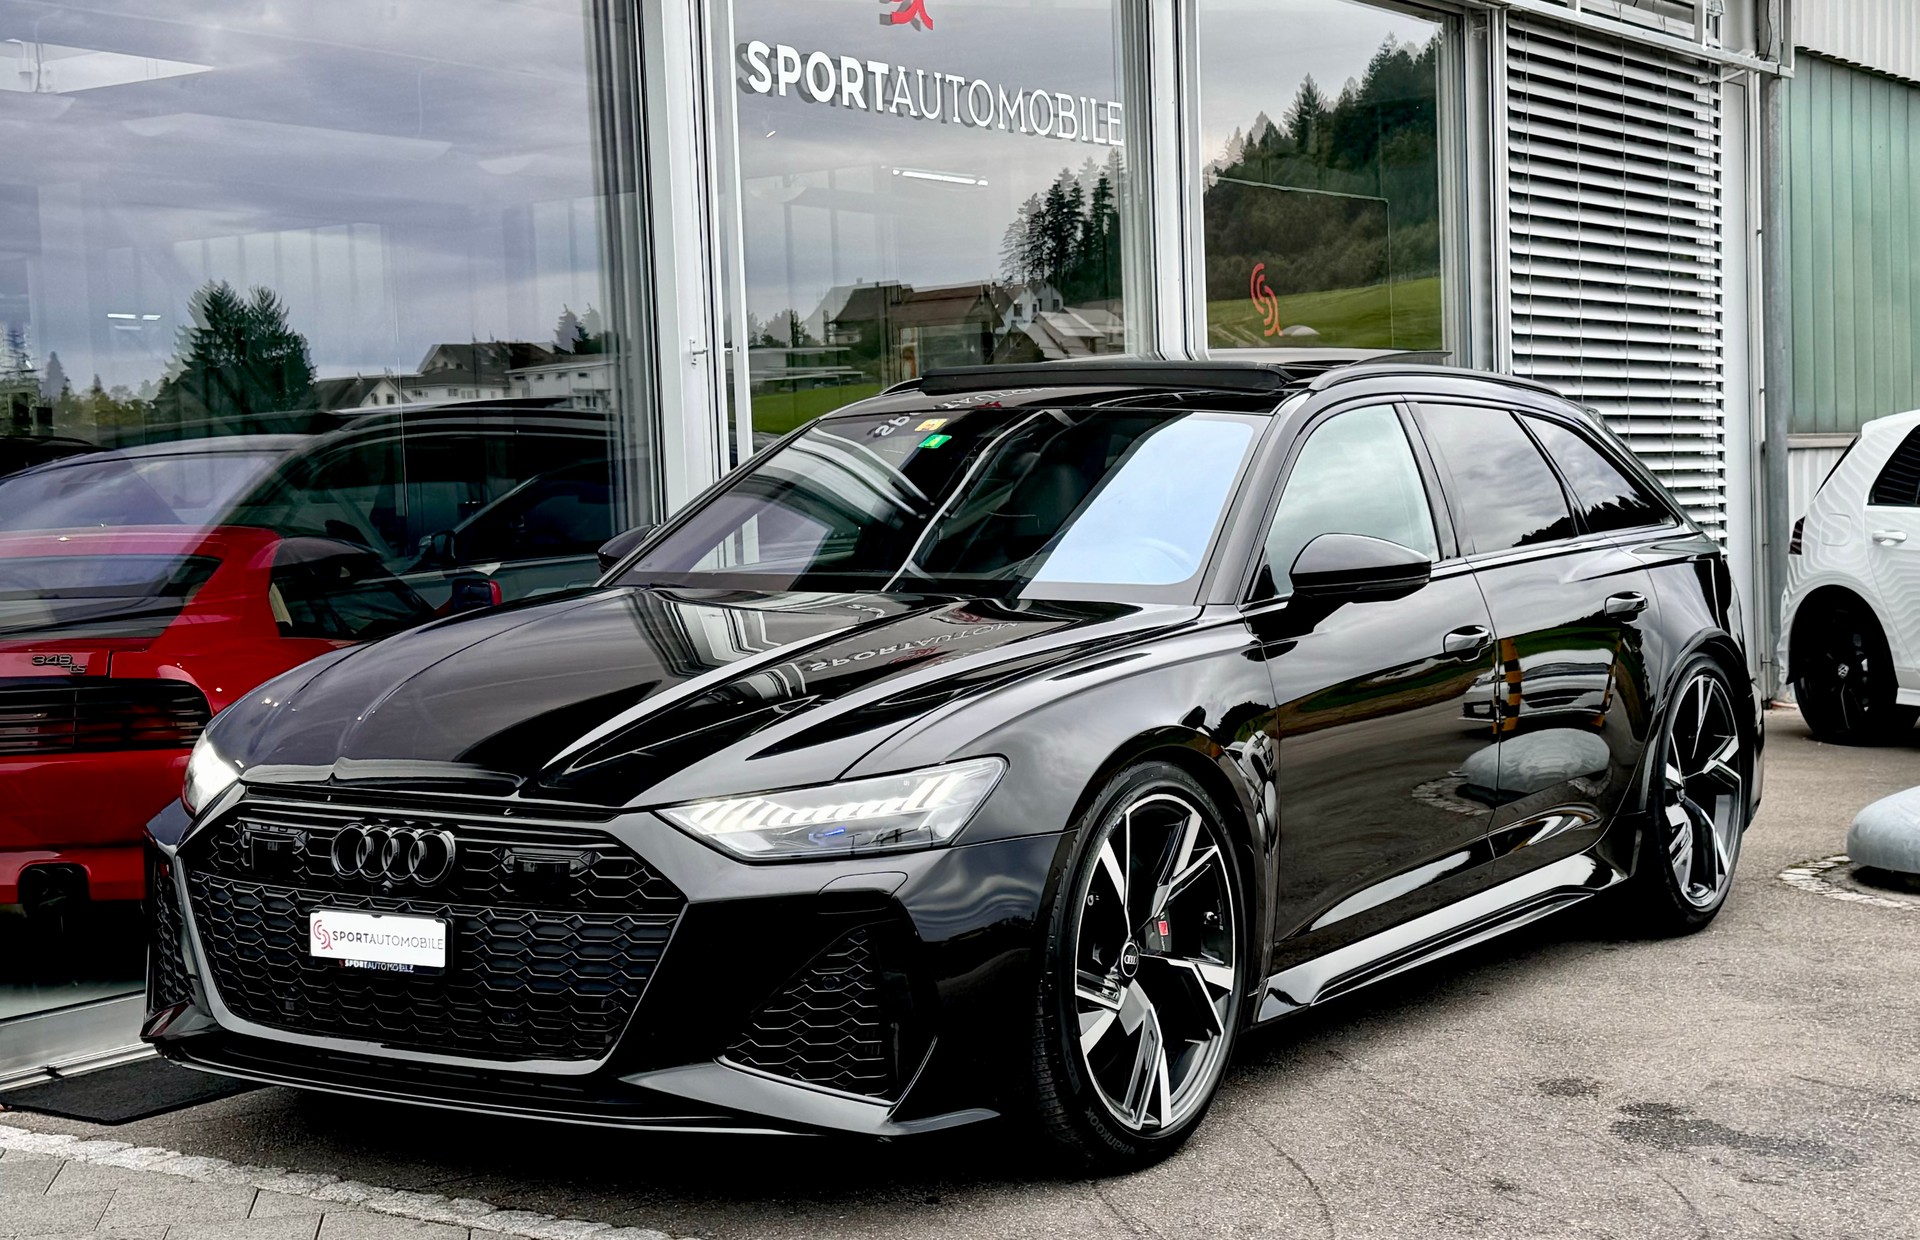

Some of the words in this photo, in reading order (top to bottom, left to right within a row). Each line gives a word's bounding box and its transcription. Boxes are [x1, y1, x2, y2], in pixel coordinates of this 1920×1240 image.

[747, 40, 1125, 146] SPORTAUTOMOBILE
[32, 654, 73, 666] 348
[332, 930, 444, 950] SPORTAUTOMOBILE
